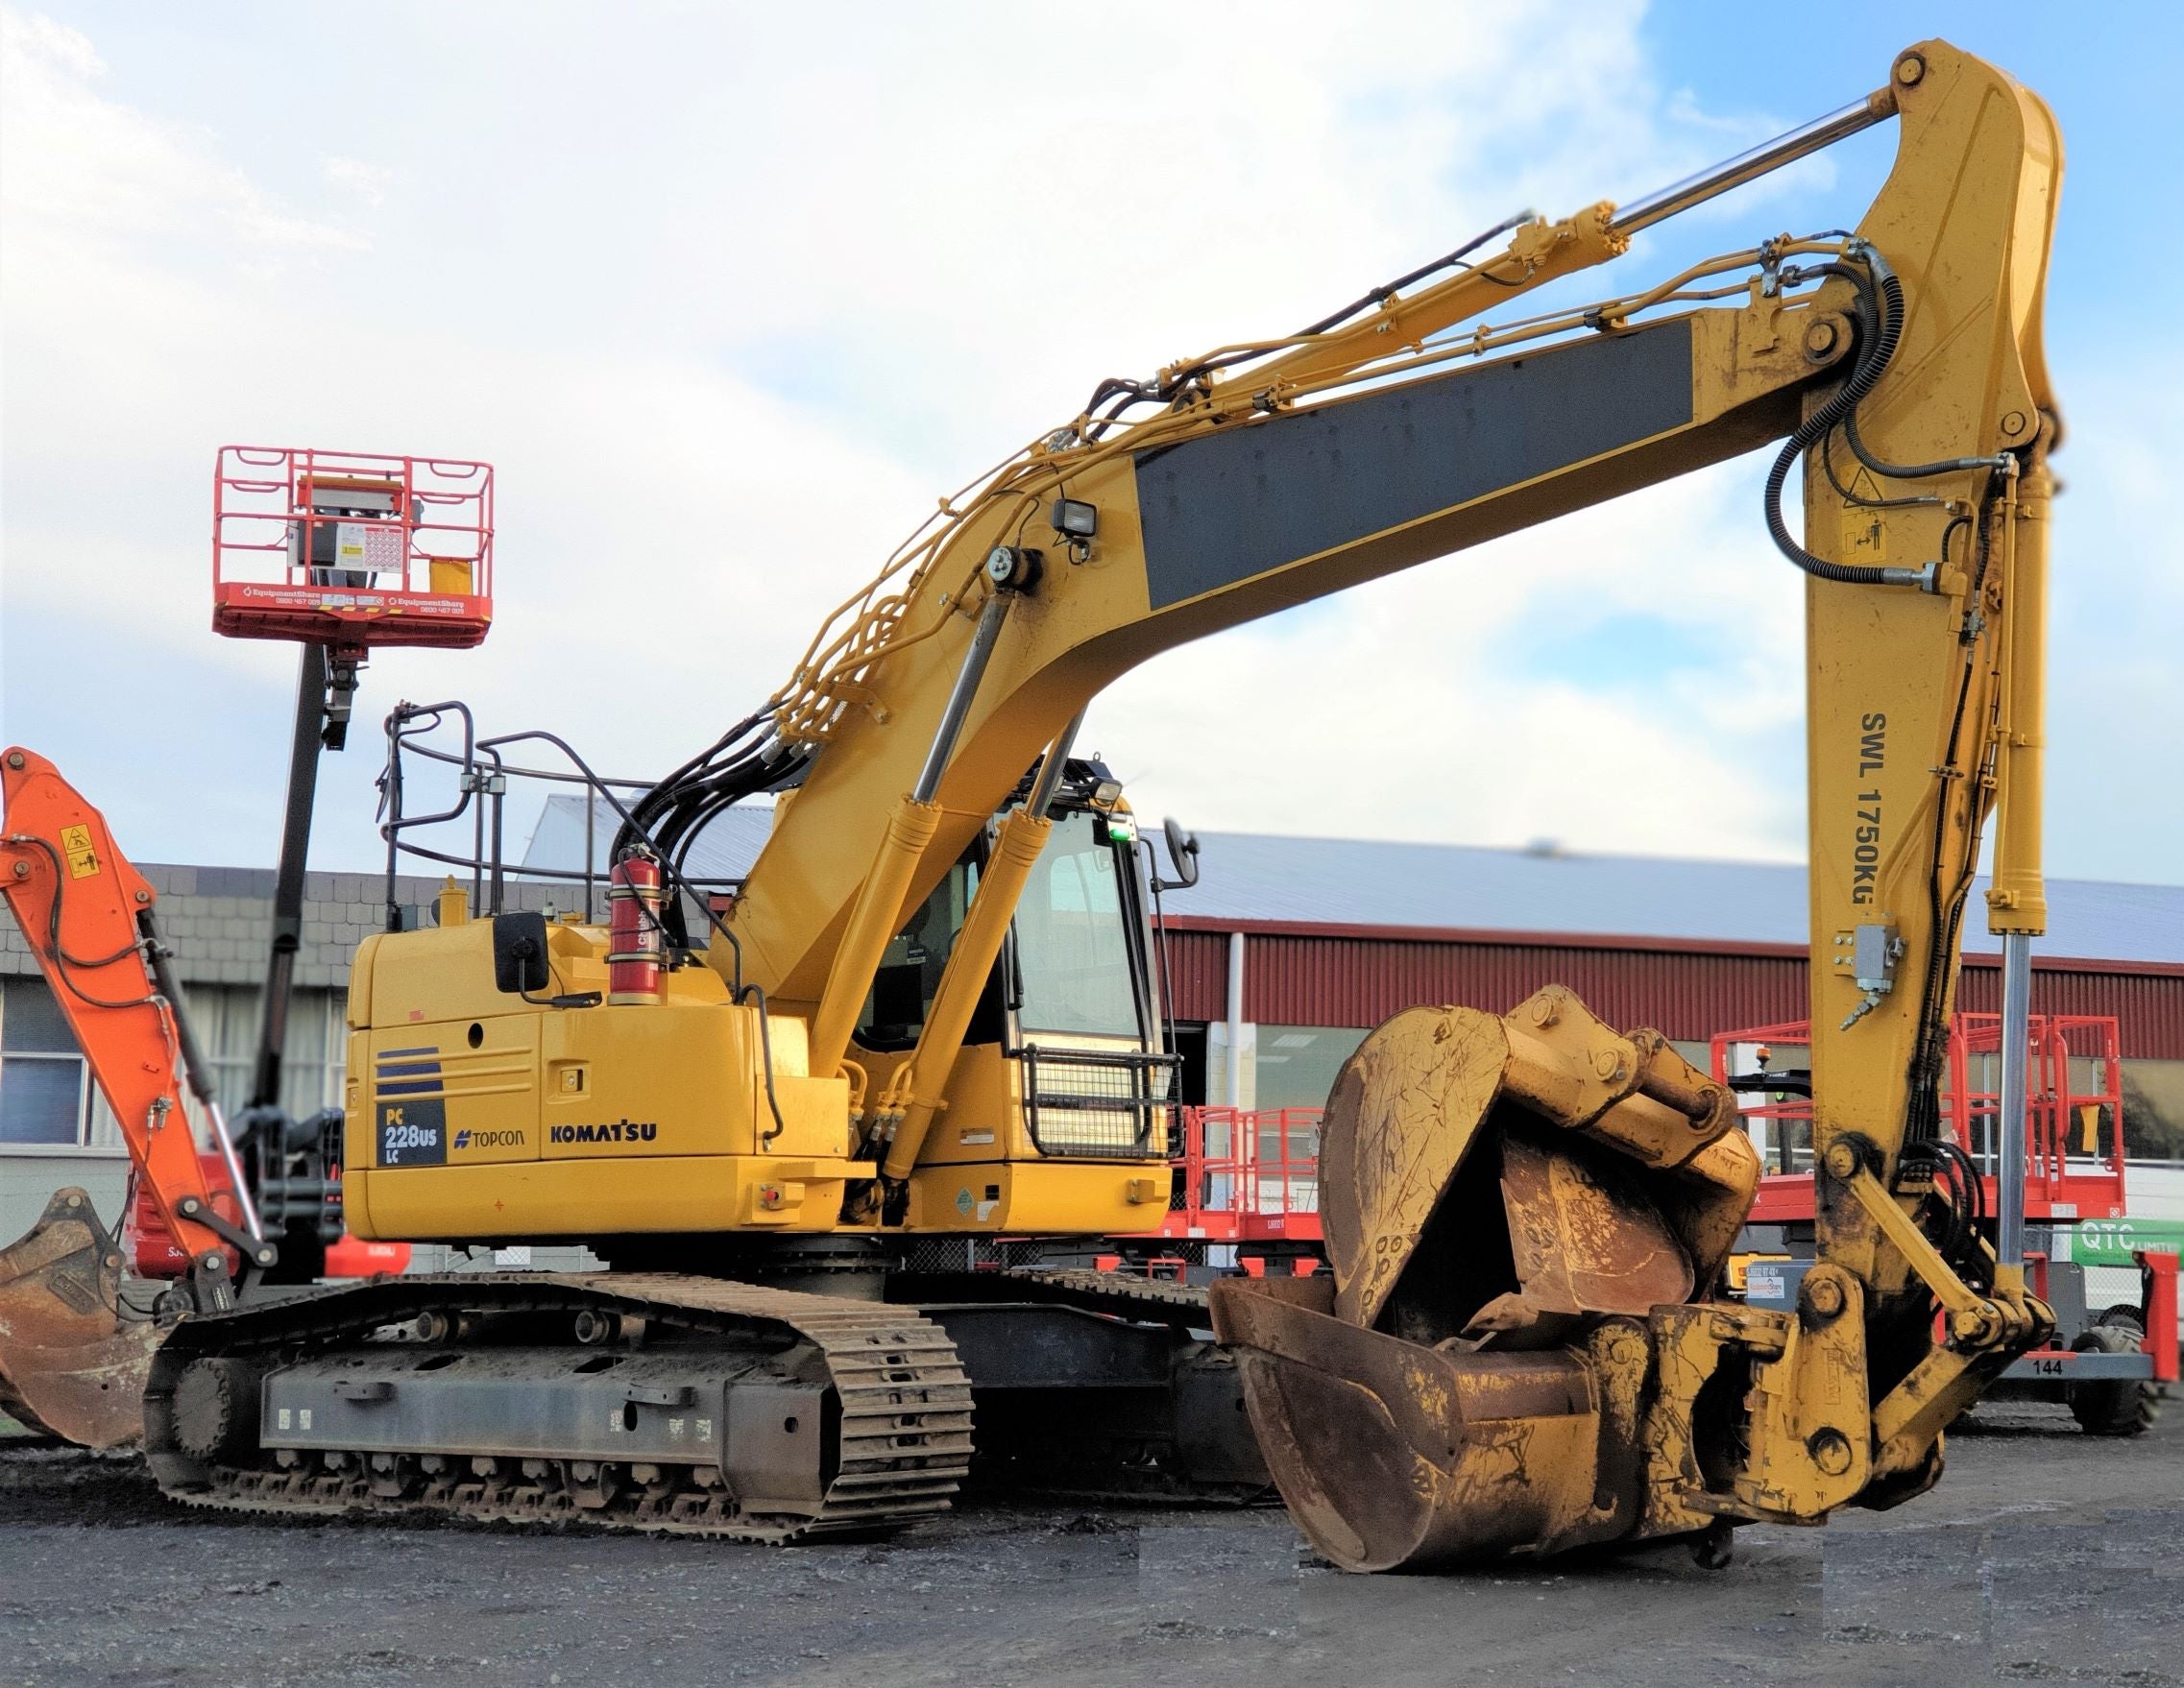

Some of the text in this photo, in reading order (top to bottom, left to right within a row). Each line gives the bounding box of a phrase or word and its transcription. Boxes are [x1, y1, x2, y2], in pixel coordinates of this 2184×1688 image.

[1852, 712, 1887, 904] SWL 1750KG
[386, 1107, 403, 1126] PC
[550, 1119, 658, 1144] KOMATSU
[386, 1149, 400, 1164] LC
[2081, 1221, 2136, 1251] QTC
[2032, 1360, 2063, 1375] 144
